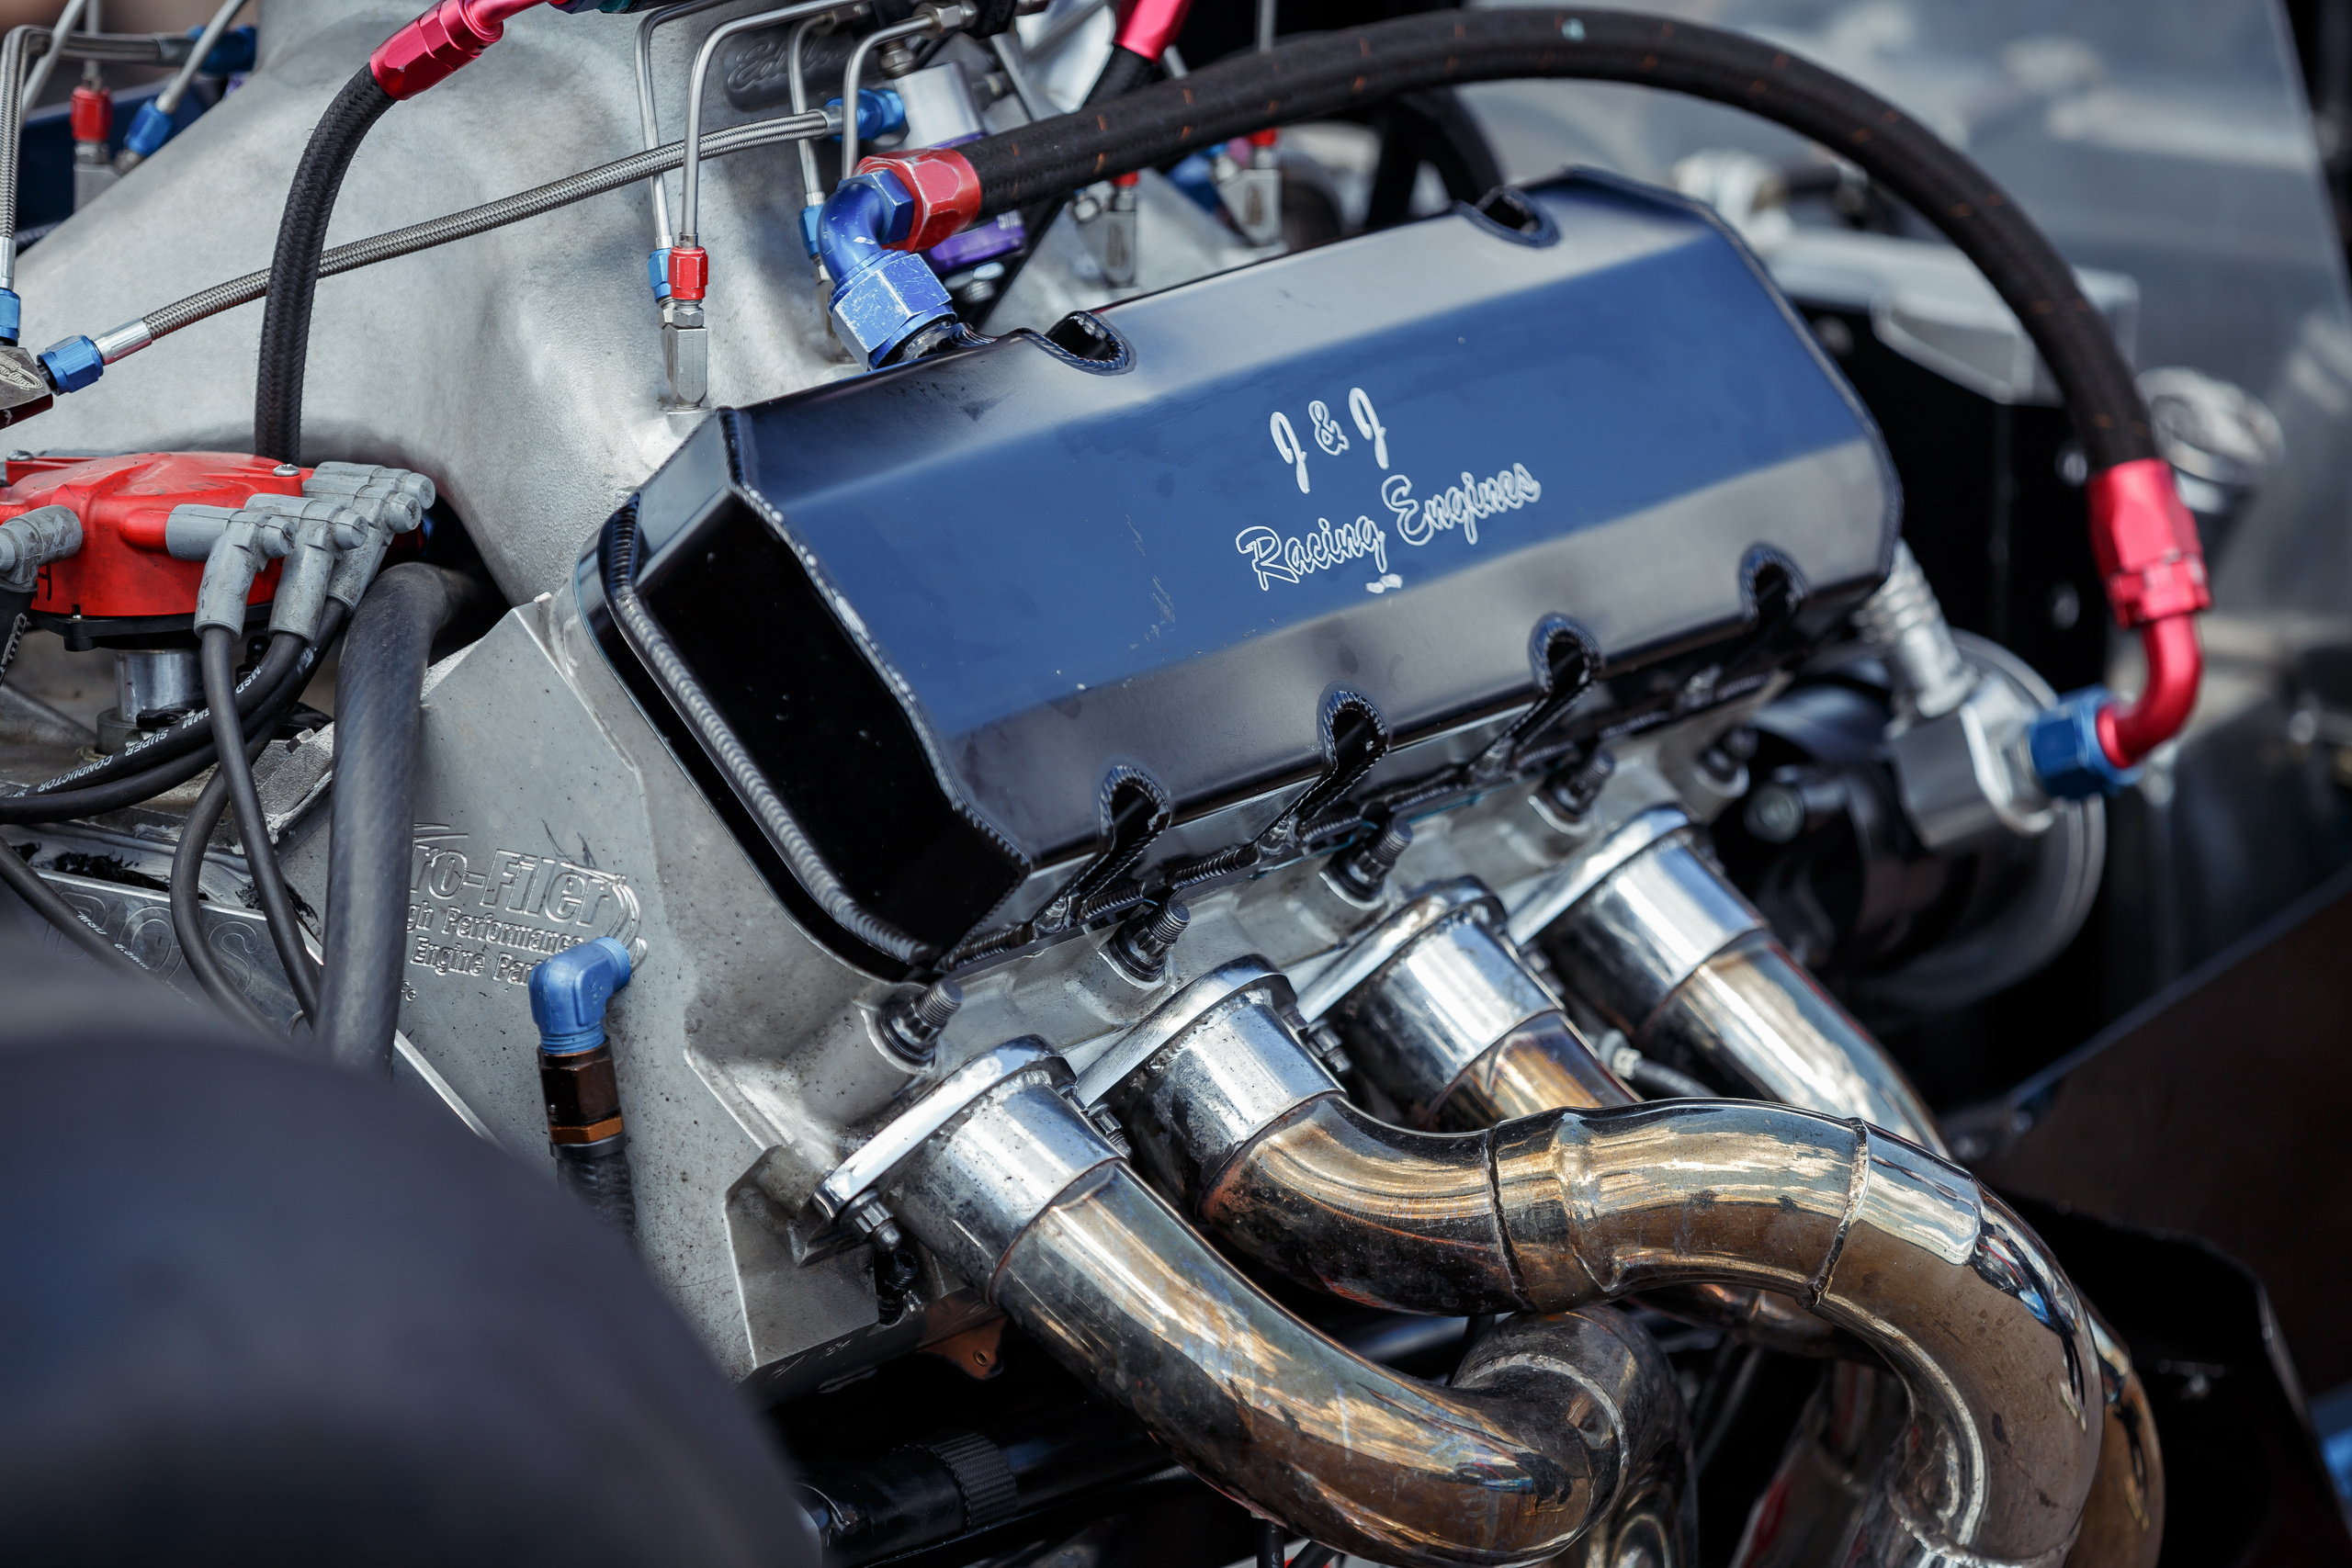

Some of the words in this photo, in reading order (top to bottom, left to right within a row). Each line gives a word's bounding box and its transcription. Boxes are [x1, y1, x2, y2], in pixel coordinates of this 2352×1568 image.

[1270, 412, 1310, 494] J
[1308, 400, 1350, 456] &
[1349, 387, 1390, 470] J
[1235, 513, 1387, 591] Racing
[1381, 462, 1543, 547] Engines
[235, 665, 262, 694] MSD
[124, 728, 168, 757] SUPER
[38, 754, 113, 792] CONDUCTOR
[410, 935, 486, 976] Engine
